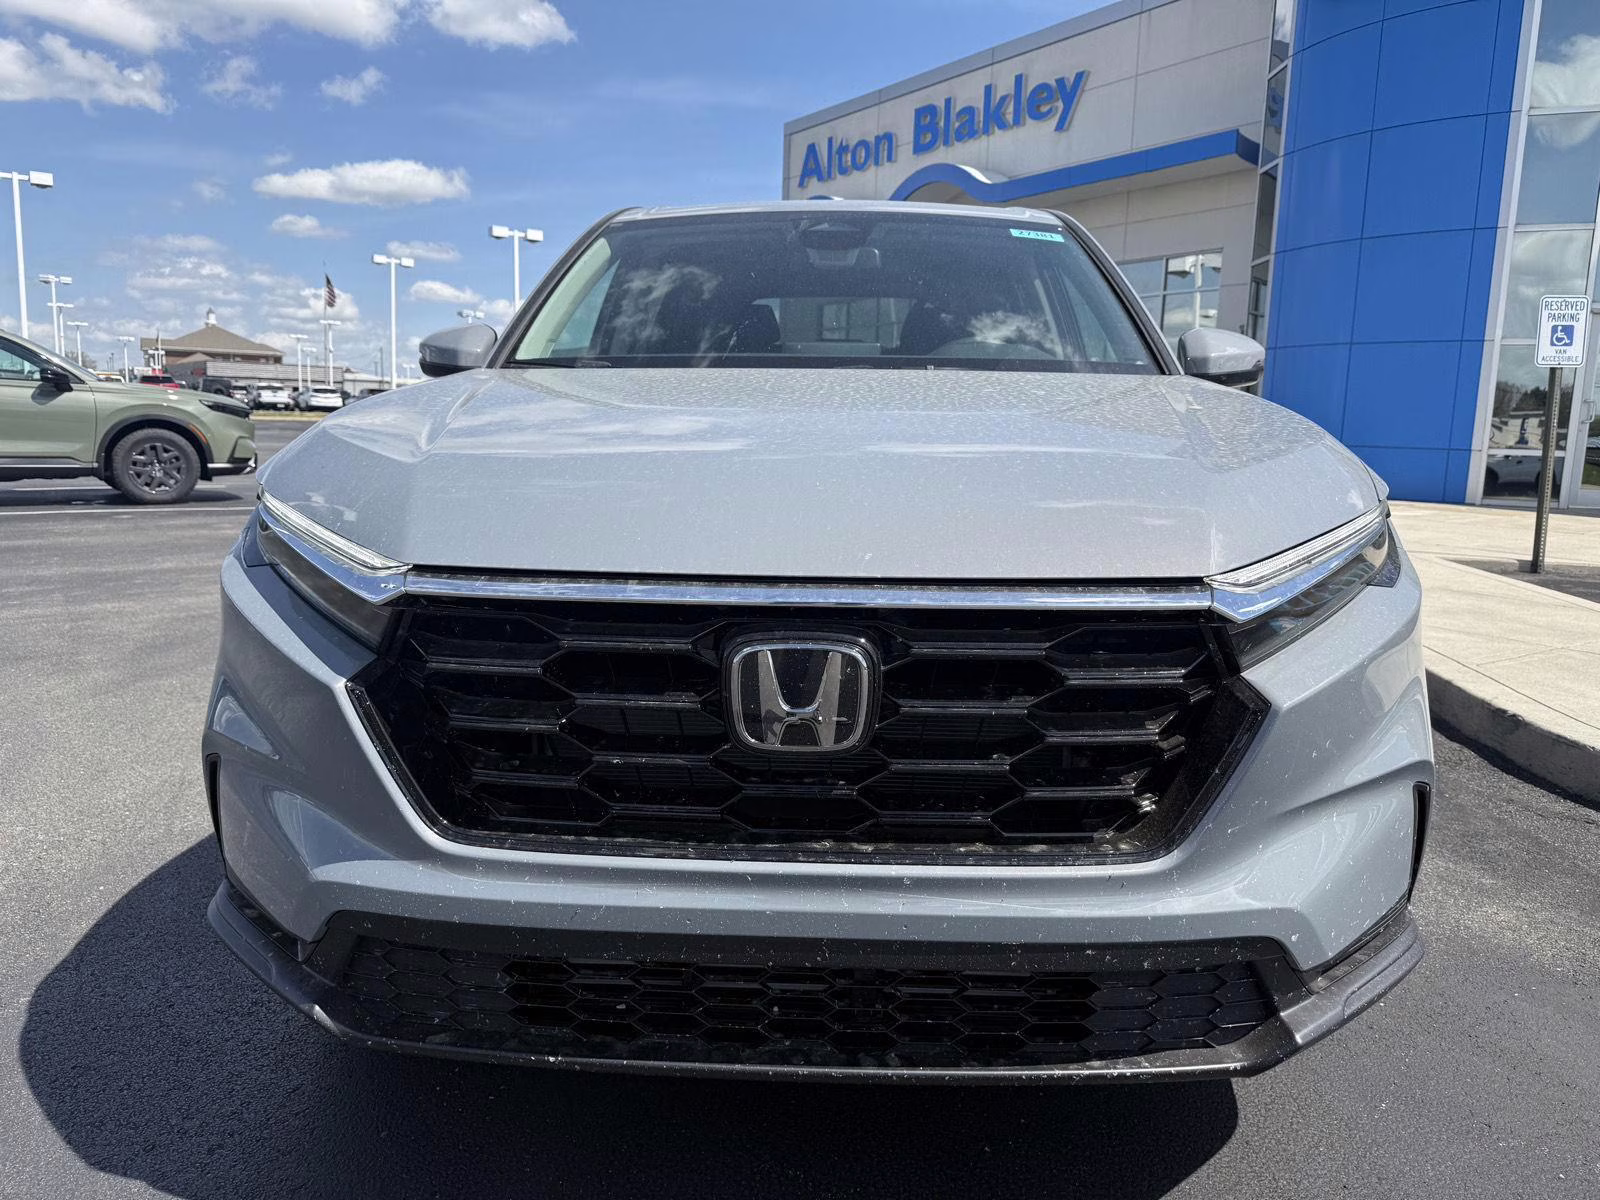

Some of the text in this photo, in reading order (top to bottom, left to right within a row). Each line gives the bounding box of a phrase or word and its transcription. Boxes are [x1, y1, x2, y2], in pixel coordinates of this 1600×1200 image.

[799, 70, 1089, 187] Alton Blakley
[1544, 300, 1585, 311] RESERVED
[1547, 312, 1580, 322] PARKING
